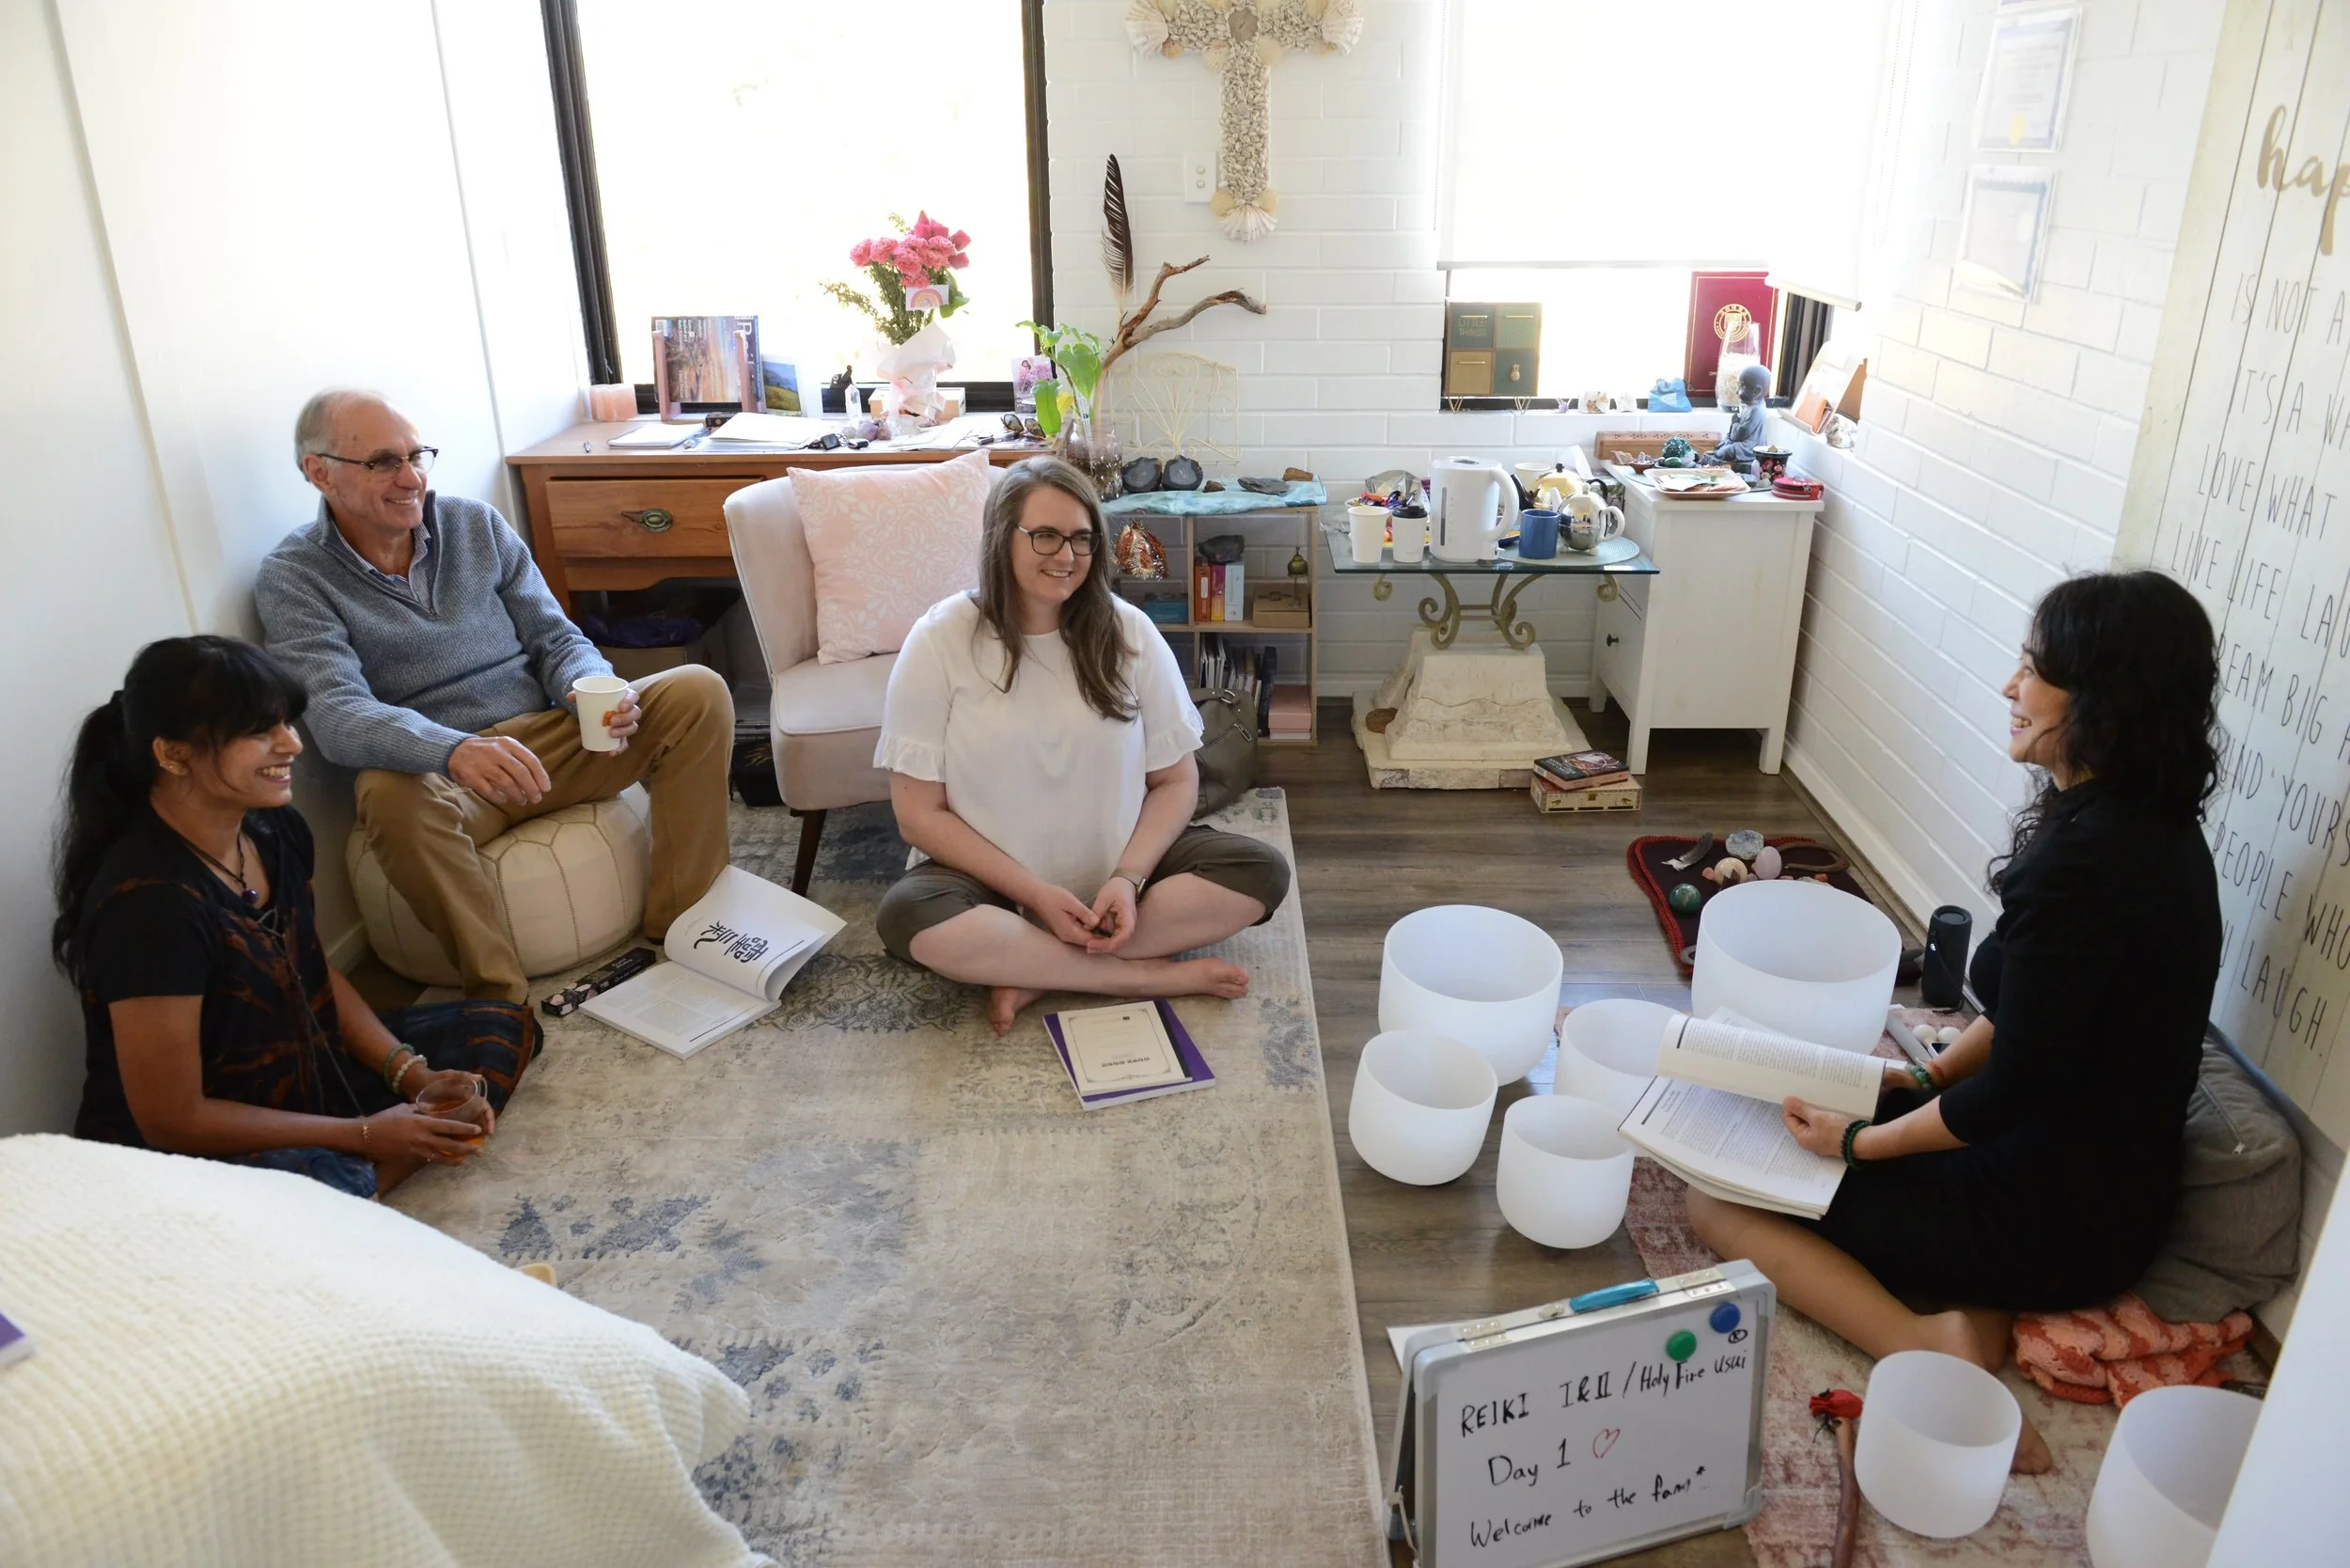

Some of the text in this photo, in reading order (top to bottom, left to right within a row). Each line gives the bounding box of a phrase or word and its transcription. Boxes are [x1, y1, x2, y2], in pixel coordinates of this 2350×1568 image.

[1459, 328, 1486, 337] THINGS
[2232, 273, 2345, 345] IS NOT A
[2229, 365, 2278, 425] IT'S
[2286, 382, 2304, 434] A
[2199, 444, 2338, 540] LOVE WHAT
[2171, 522, 2221, 588] LIVE
[2228, 549, 2282, 619] LIFE
[2281, 674, 2327, 745] BIG
[2213, 822, 2350, 970] PEOPLE WHO
[2241, 940, 2327, 1058] LAUGH.
[1462, 1392, 1529, 1437] REIKI
[1488, 1438, 1571, 1486] Day 1
[1470, 1513, 1552, 1547] Welcome
[1573, 1499, 1592, 1517] to
[1606, 1487, 1637, 1509] the
